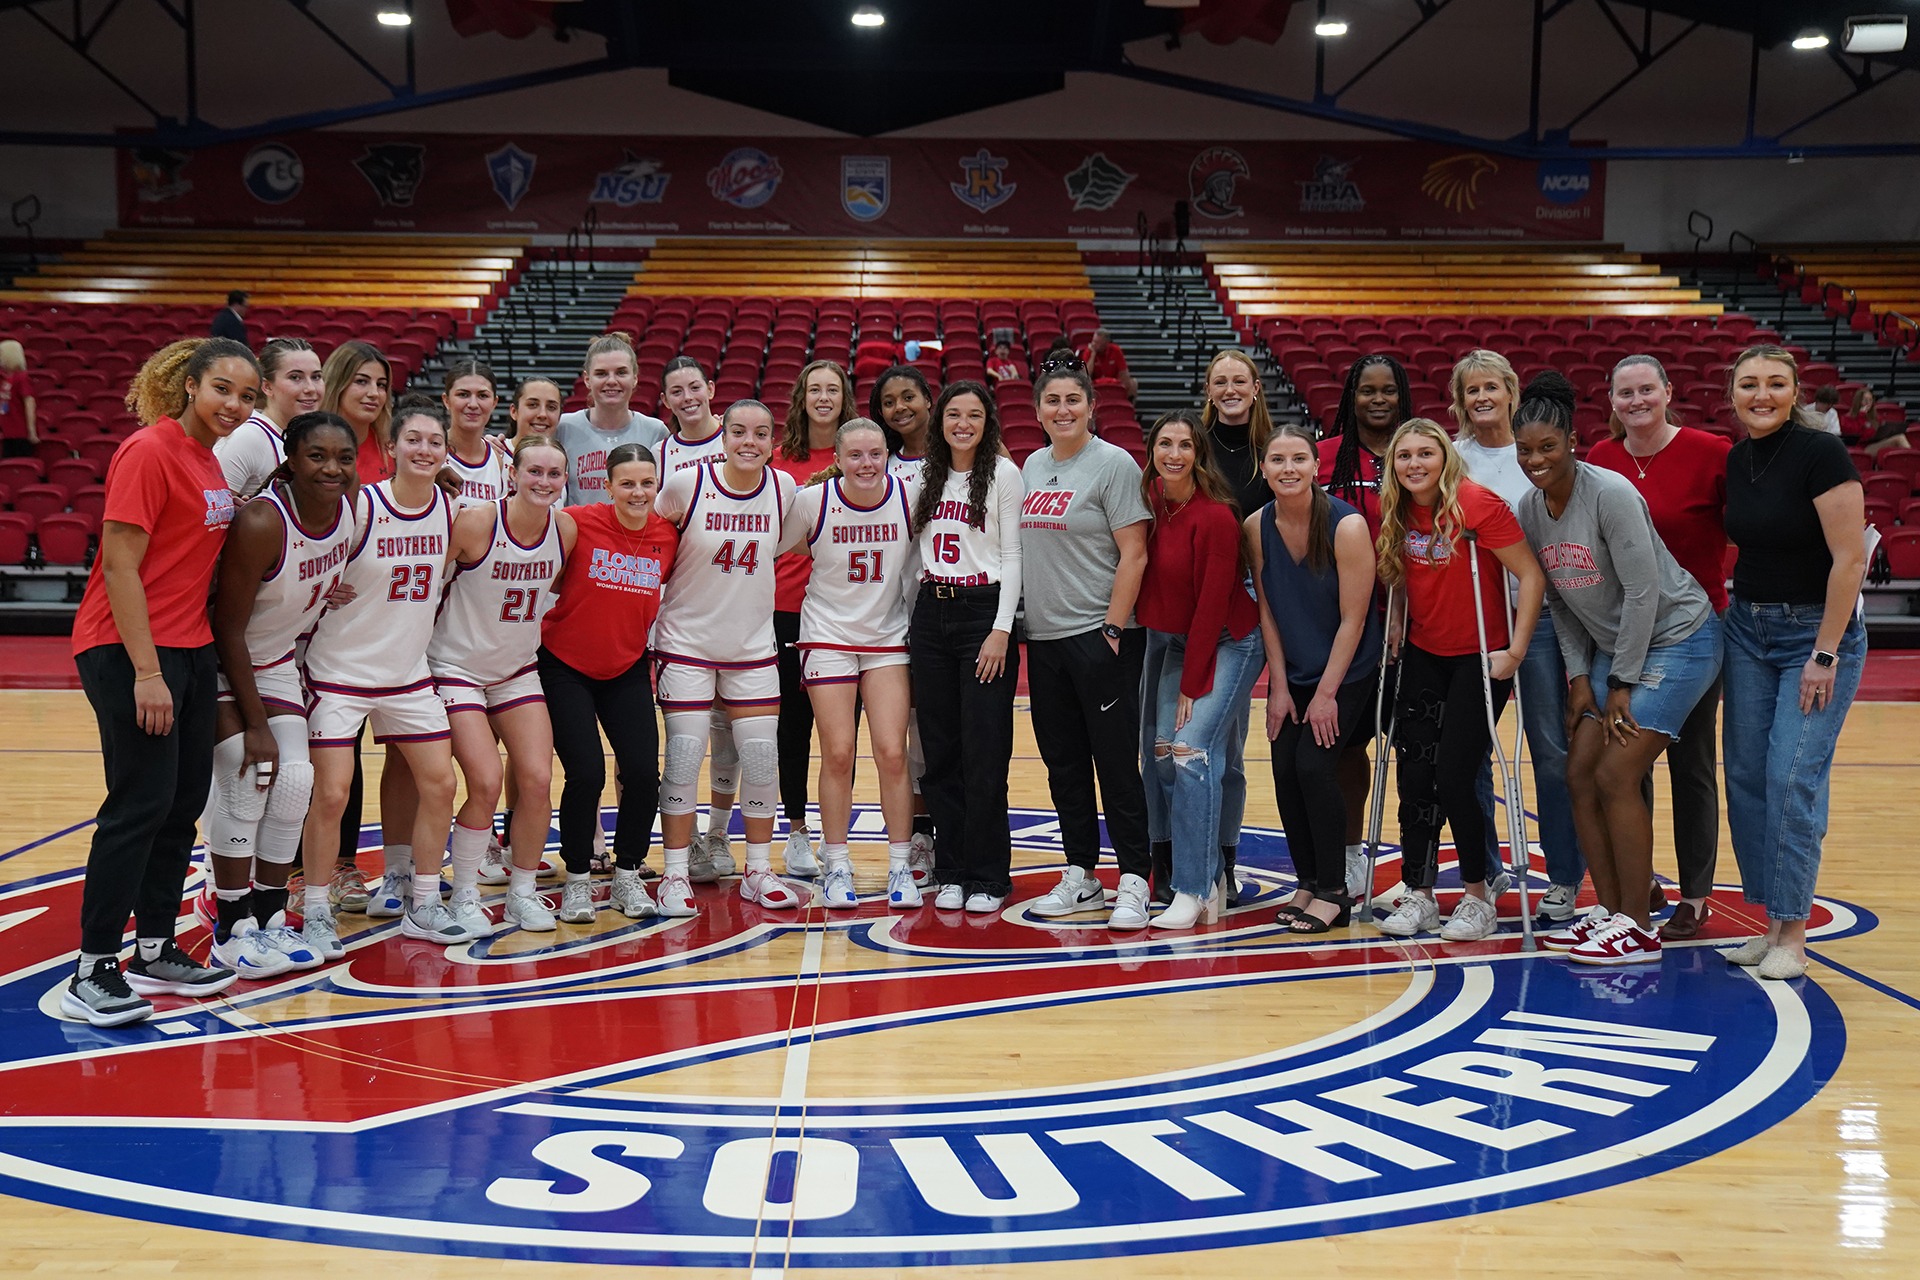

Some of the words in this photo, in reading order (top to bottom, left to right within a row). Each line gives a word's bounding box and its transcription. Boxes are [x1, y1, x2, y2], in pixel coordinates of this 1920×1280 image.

[592, 174, 670, 205] NSU
[1303, 183, 1361, 201] PBA
[1542, 175, 1590, 191] NCAA
[1536, 205, 1580, 219] Division
[1022, 489, 1077, 519] MOCS
[704, 512, 772, 534] SOUTHERN
[831, 523, 899, 544] SOUTHERN
[1033, 521, 1068, 531] BASKETBALL
[298, 536, 350, 582] SOUTHERN
[376, 534, 444, 559] SOUTHERN
[712, 539, 760, 576] 44
[932, 533, 961, 565] 15
[1559, 541, 1600, 572] SOUTHERN
[491, 560, 555, 581] SOUTHERN
[588, 564, 660, 590] SOUTHERN
[591, 547, 662, 577] FLORIDA
[847, 549, 885, 585] 51
[303, 571, 342, 613] 14
[386, 563, 434, 603] 23
[595, 581, 623, 591] WOMEN'S
[623, 586, 654, 596] BASKETBALL
[499, 587, 541, 623] 21
[484, 1010, 1717, 1220] SOUTHERN
